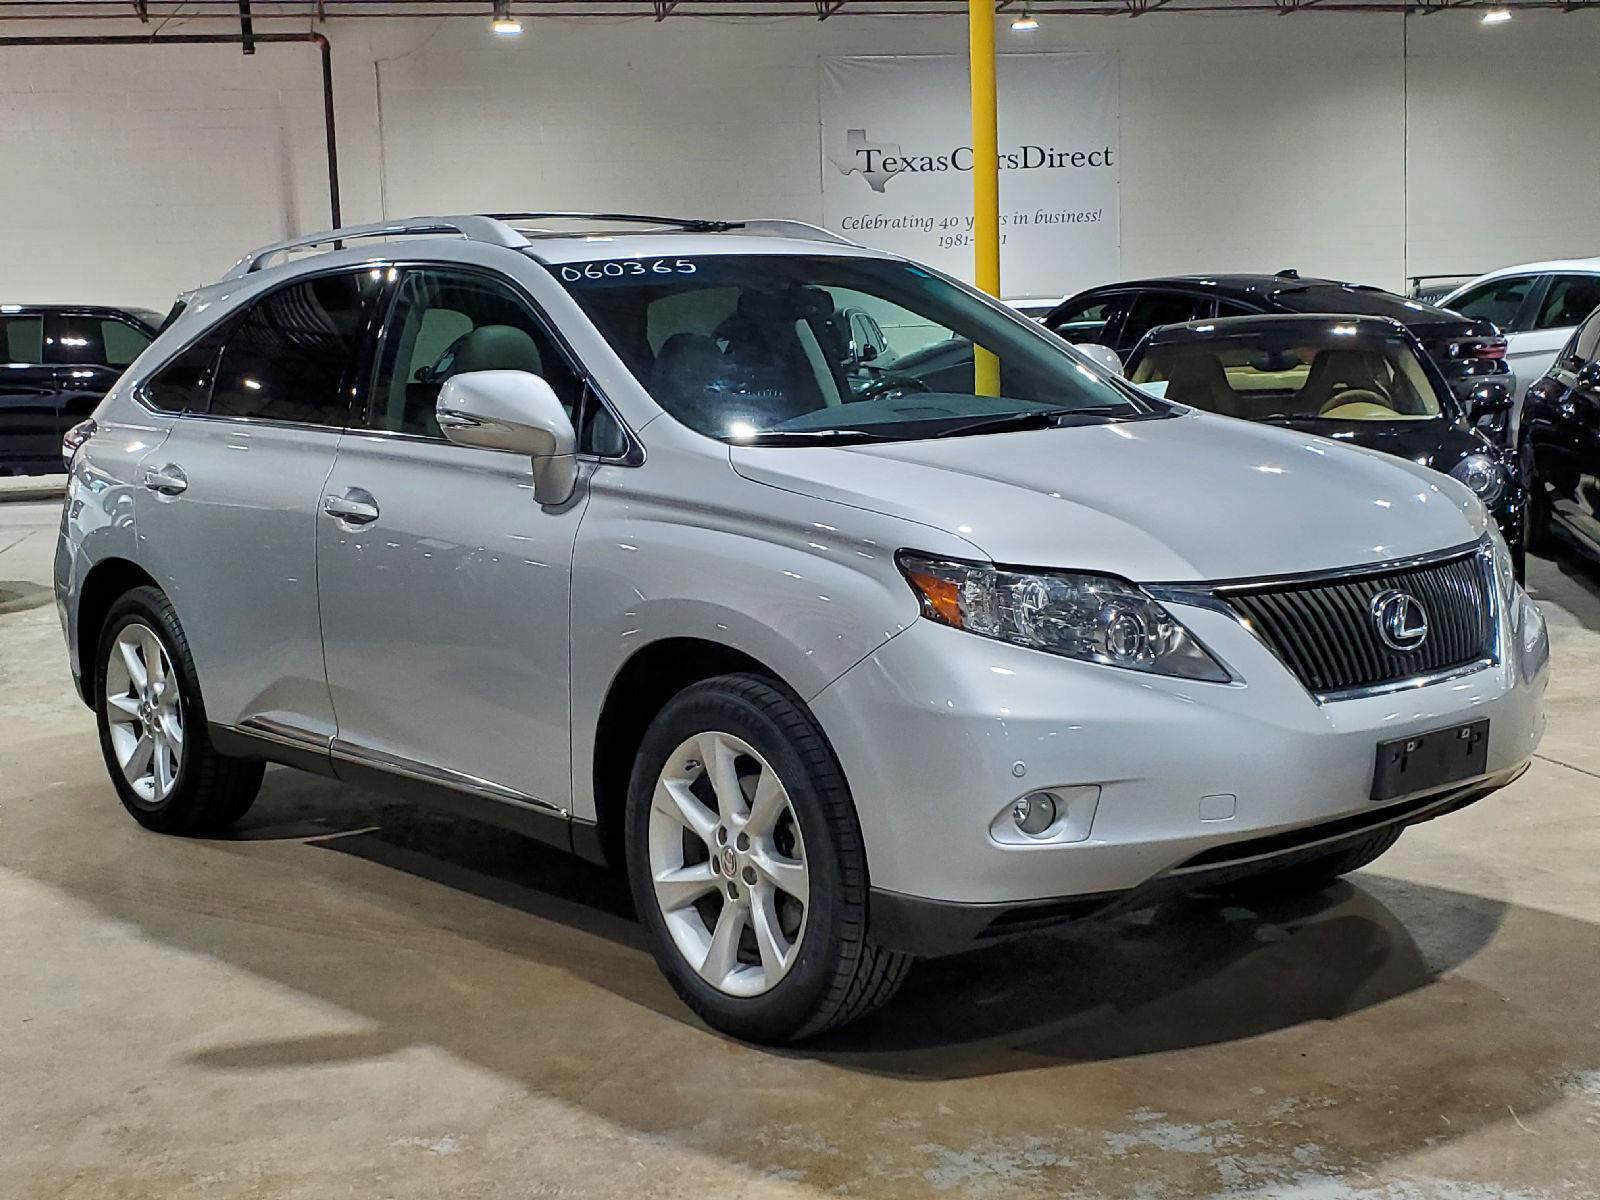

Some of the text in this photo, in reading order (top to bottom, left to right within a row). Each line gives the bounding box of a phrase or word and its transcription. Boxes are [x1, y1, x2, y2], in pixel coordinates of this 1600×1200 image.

[855, 145, 1114, 173] TexasCrsDirect
[841, 213, 934, 233] Celebrating
[938, 216, 959, 230] 40
[1013, 211, 1028, 225] in
[1034, 208, 1103, 225] business!
[938, 233, 1007, 249] 1981-1
[561, 259, 697, 282] 060365
